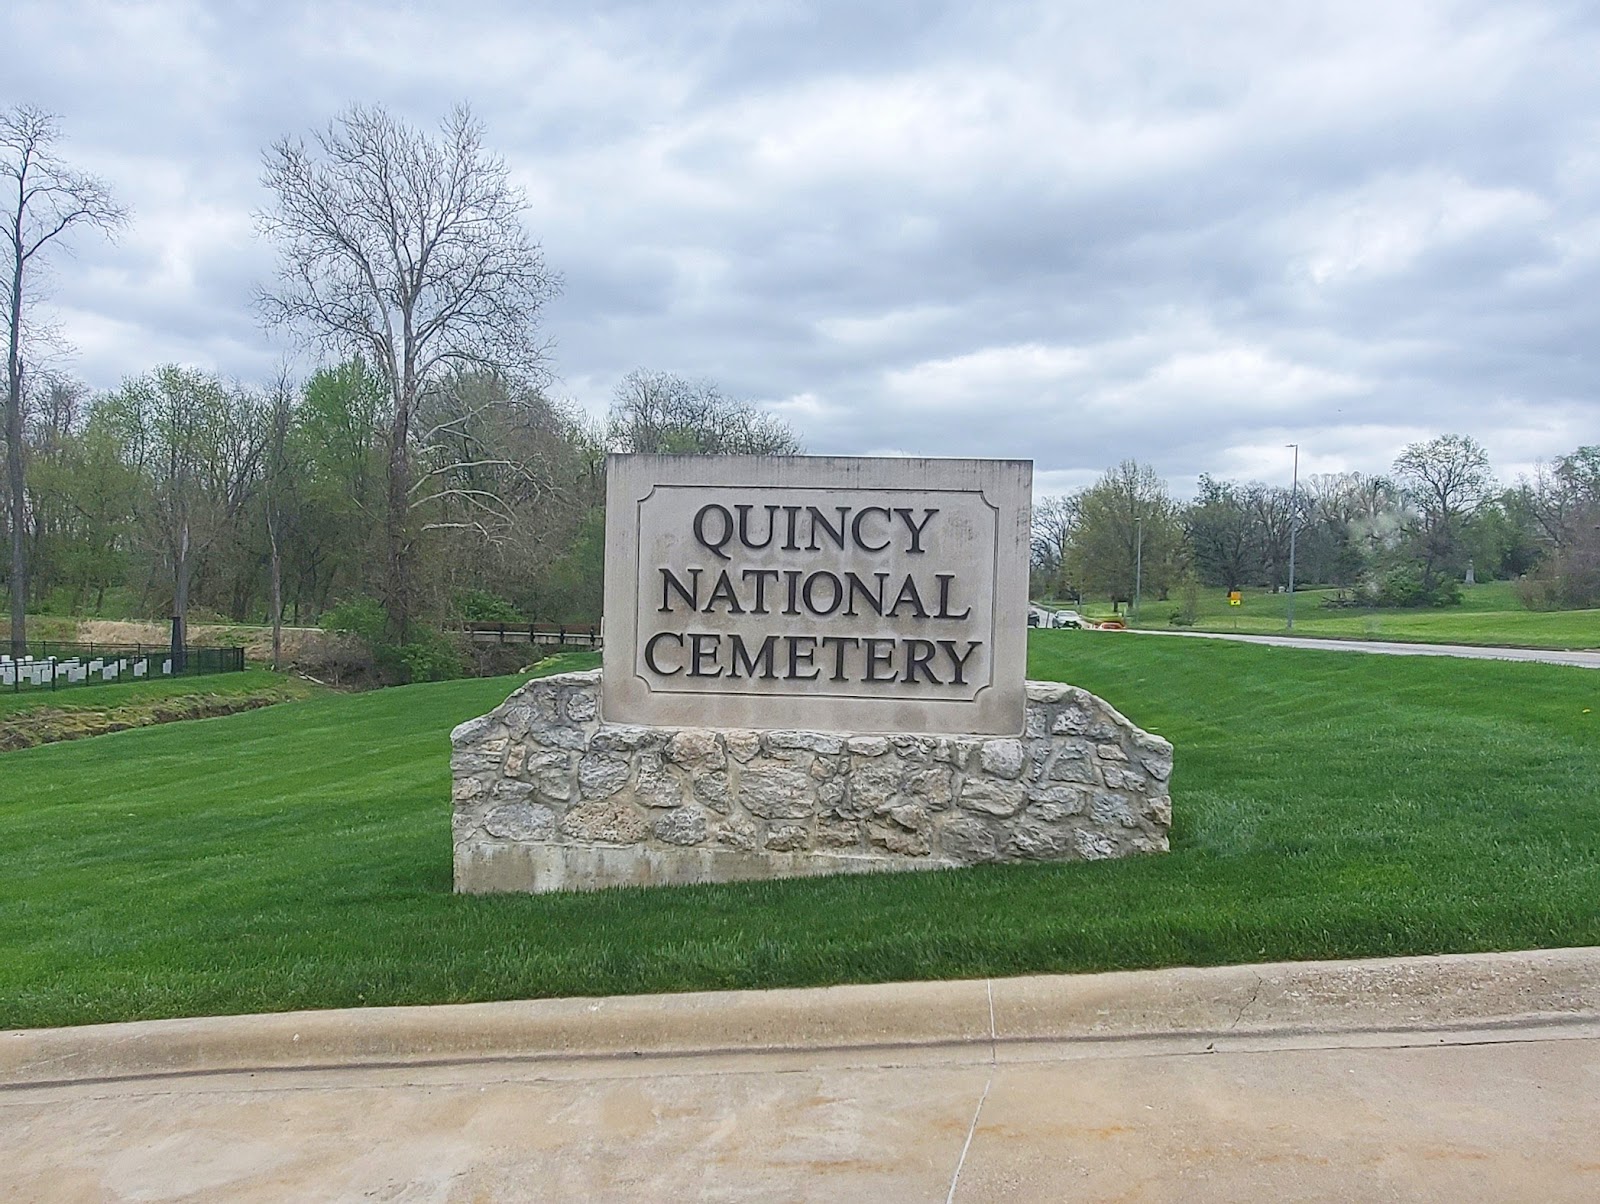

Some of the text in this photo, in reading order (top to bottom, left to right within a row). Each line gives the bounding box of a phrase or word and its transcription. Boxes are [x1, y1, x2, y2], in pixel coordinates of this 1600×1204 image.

[692, 503, 940, 561] QUINCY
[657, 568, 972, 620] NATIONAL
[644, 631, 983, 686] CEMETERY
